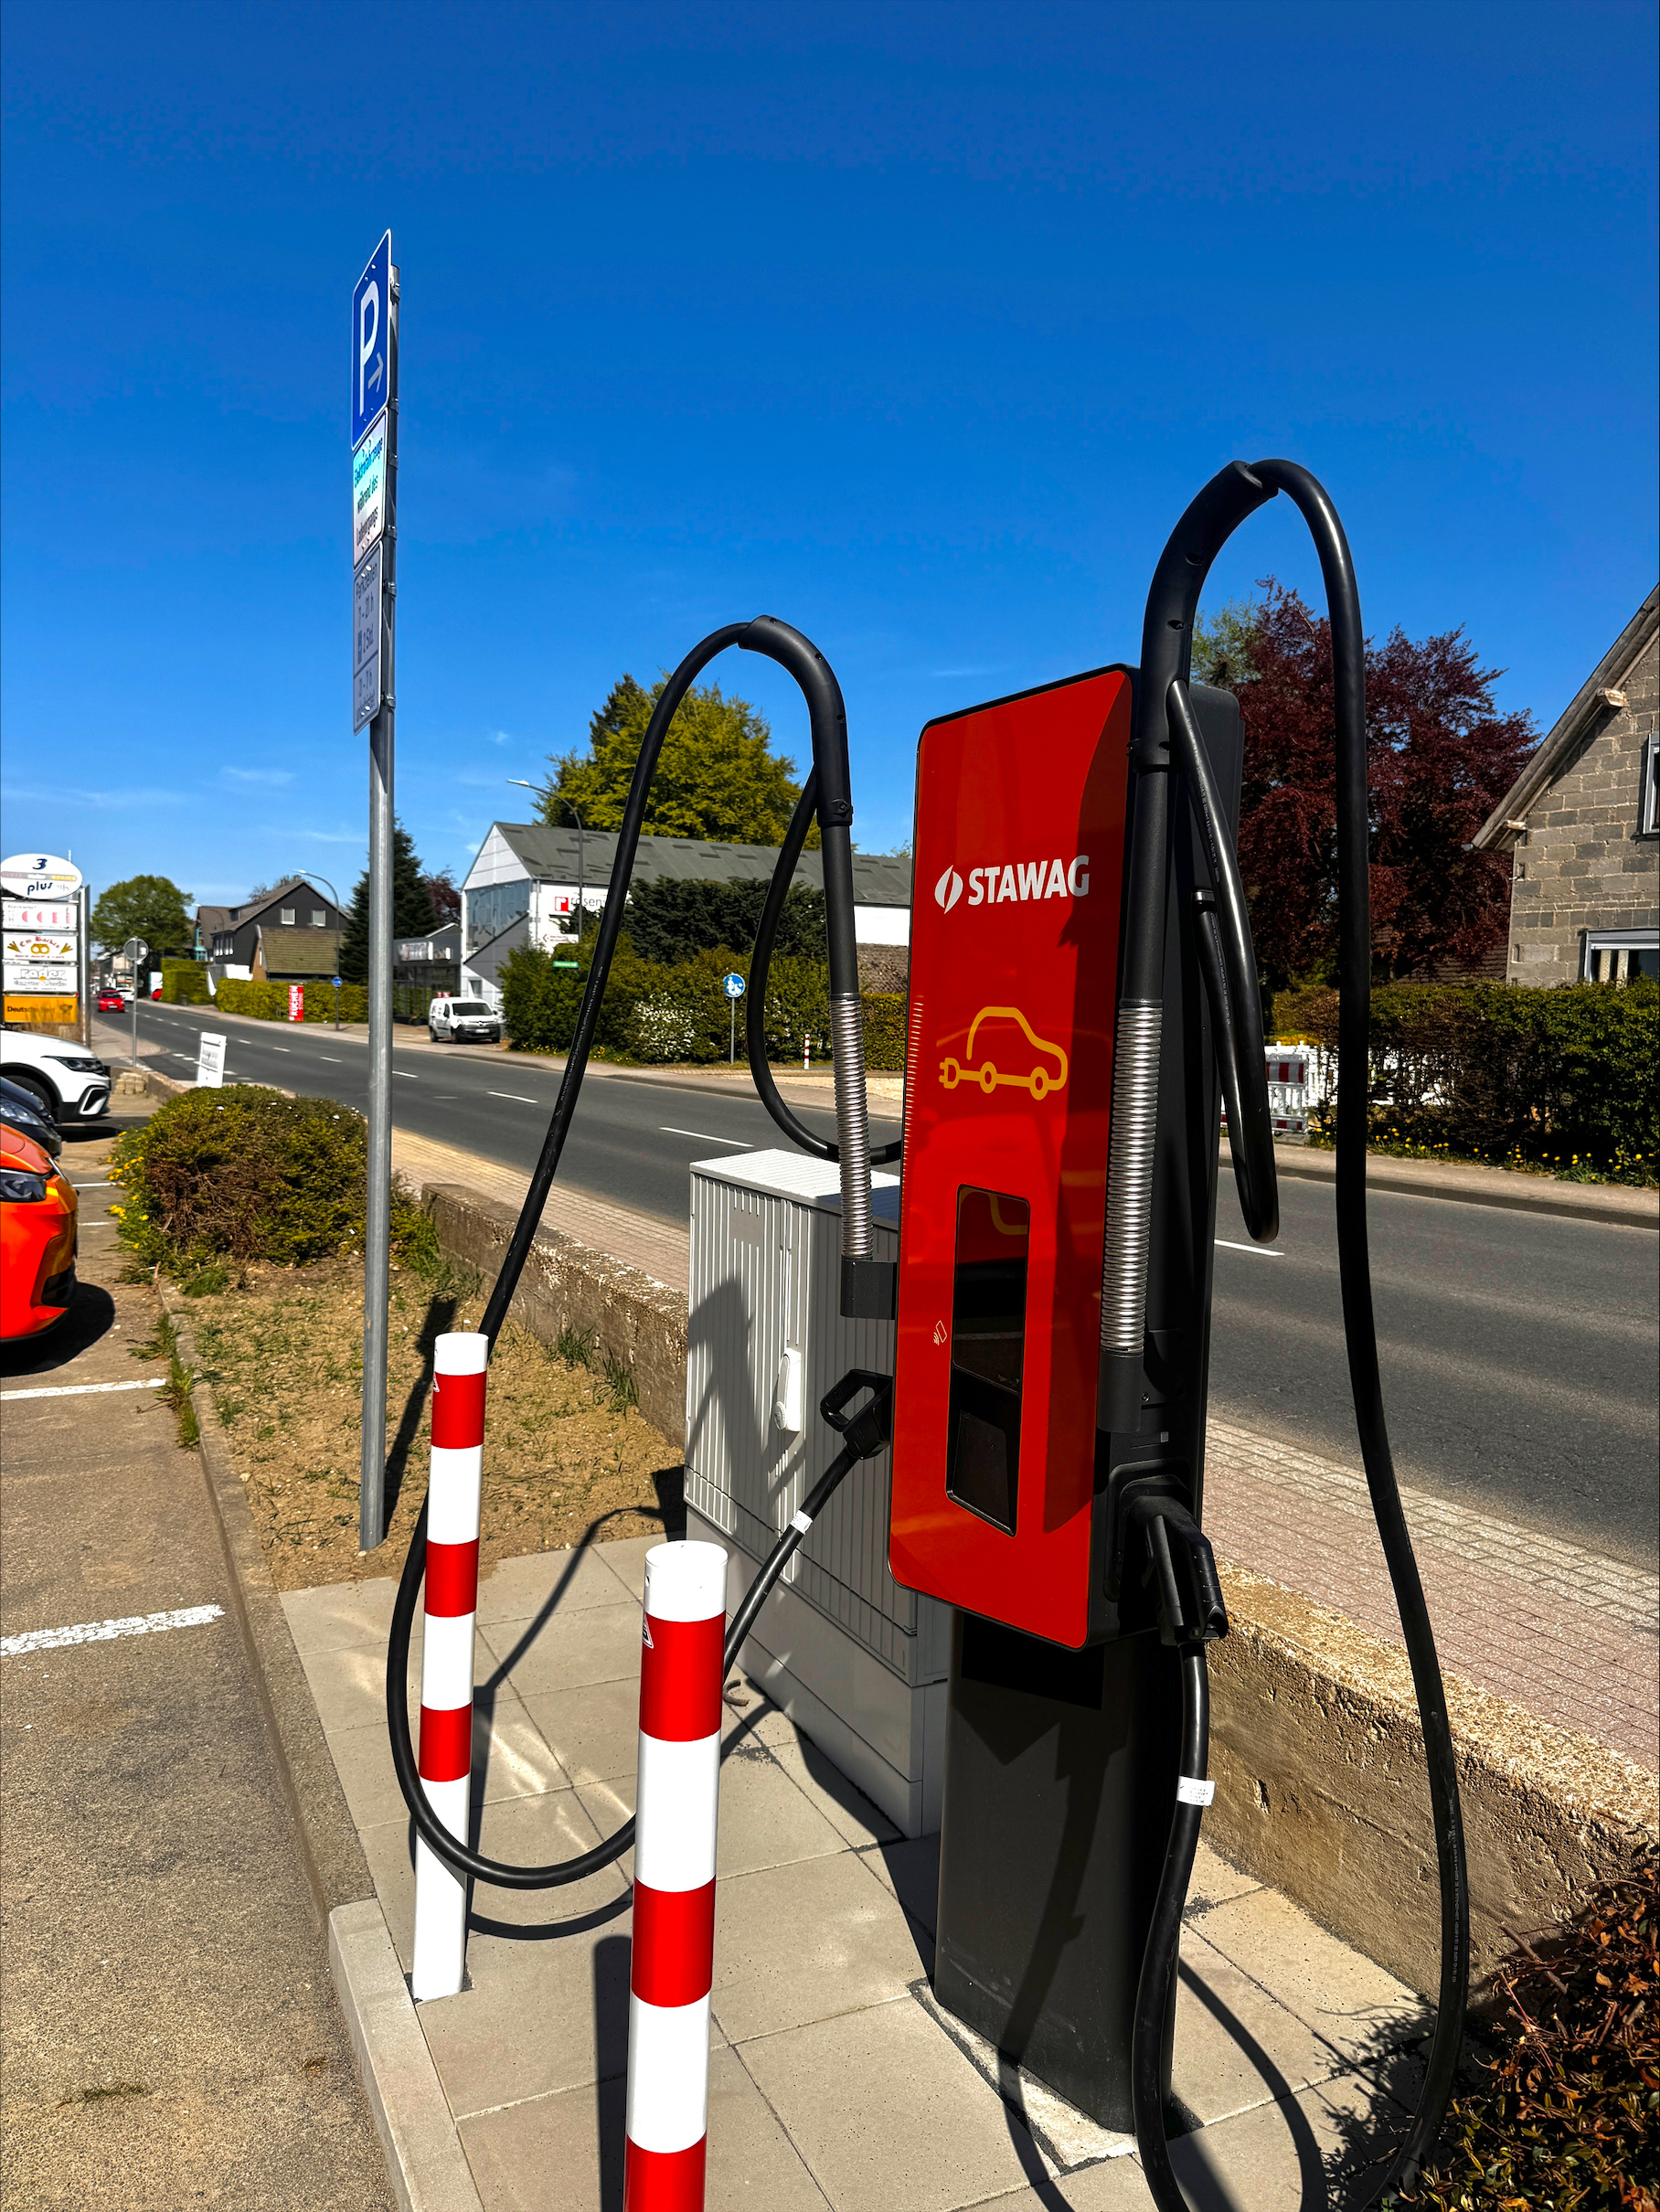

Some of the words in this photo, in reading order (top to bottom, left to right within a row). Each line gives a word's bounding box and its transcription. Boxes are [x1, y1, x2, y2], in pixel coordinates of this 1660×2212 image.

[359, 280, 380, 417] P
[32, 858, 48, 870] 3
[968, 855, 1090, 906] STAWAG
[27, 881, 53, 896] plus
